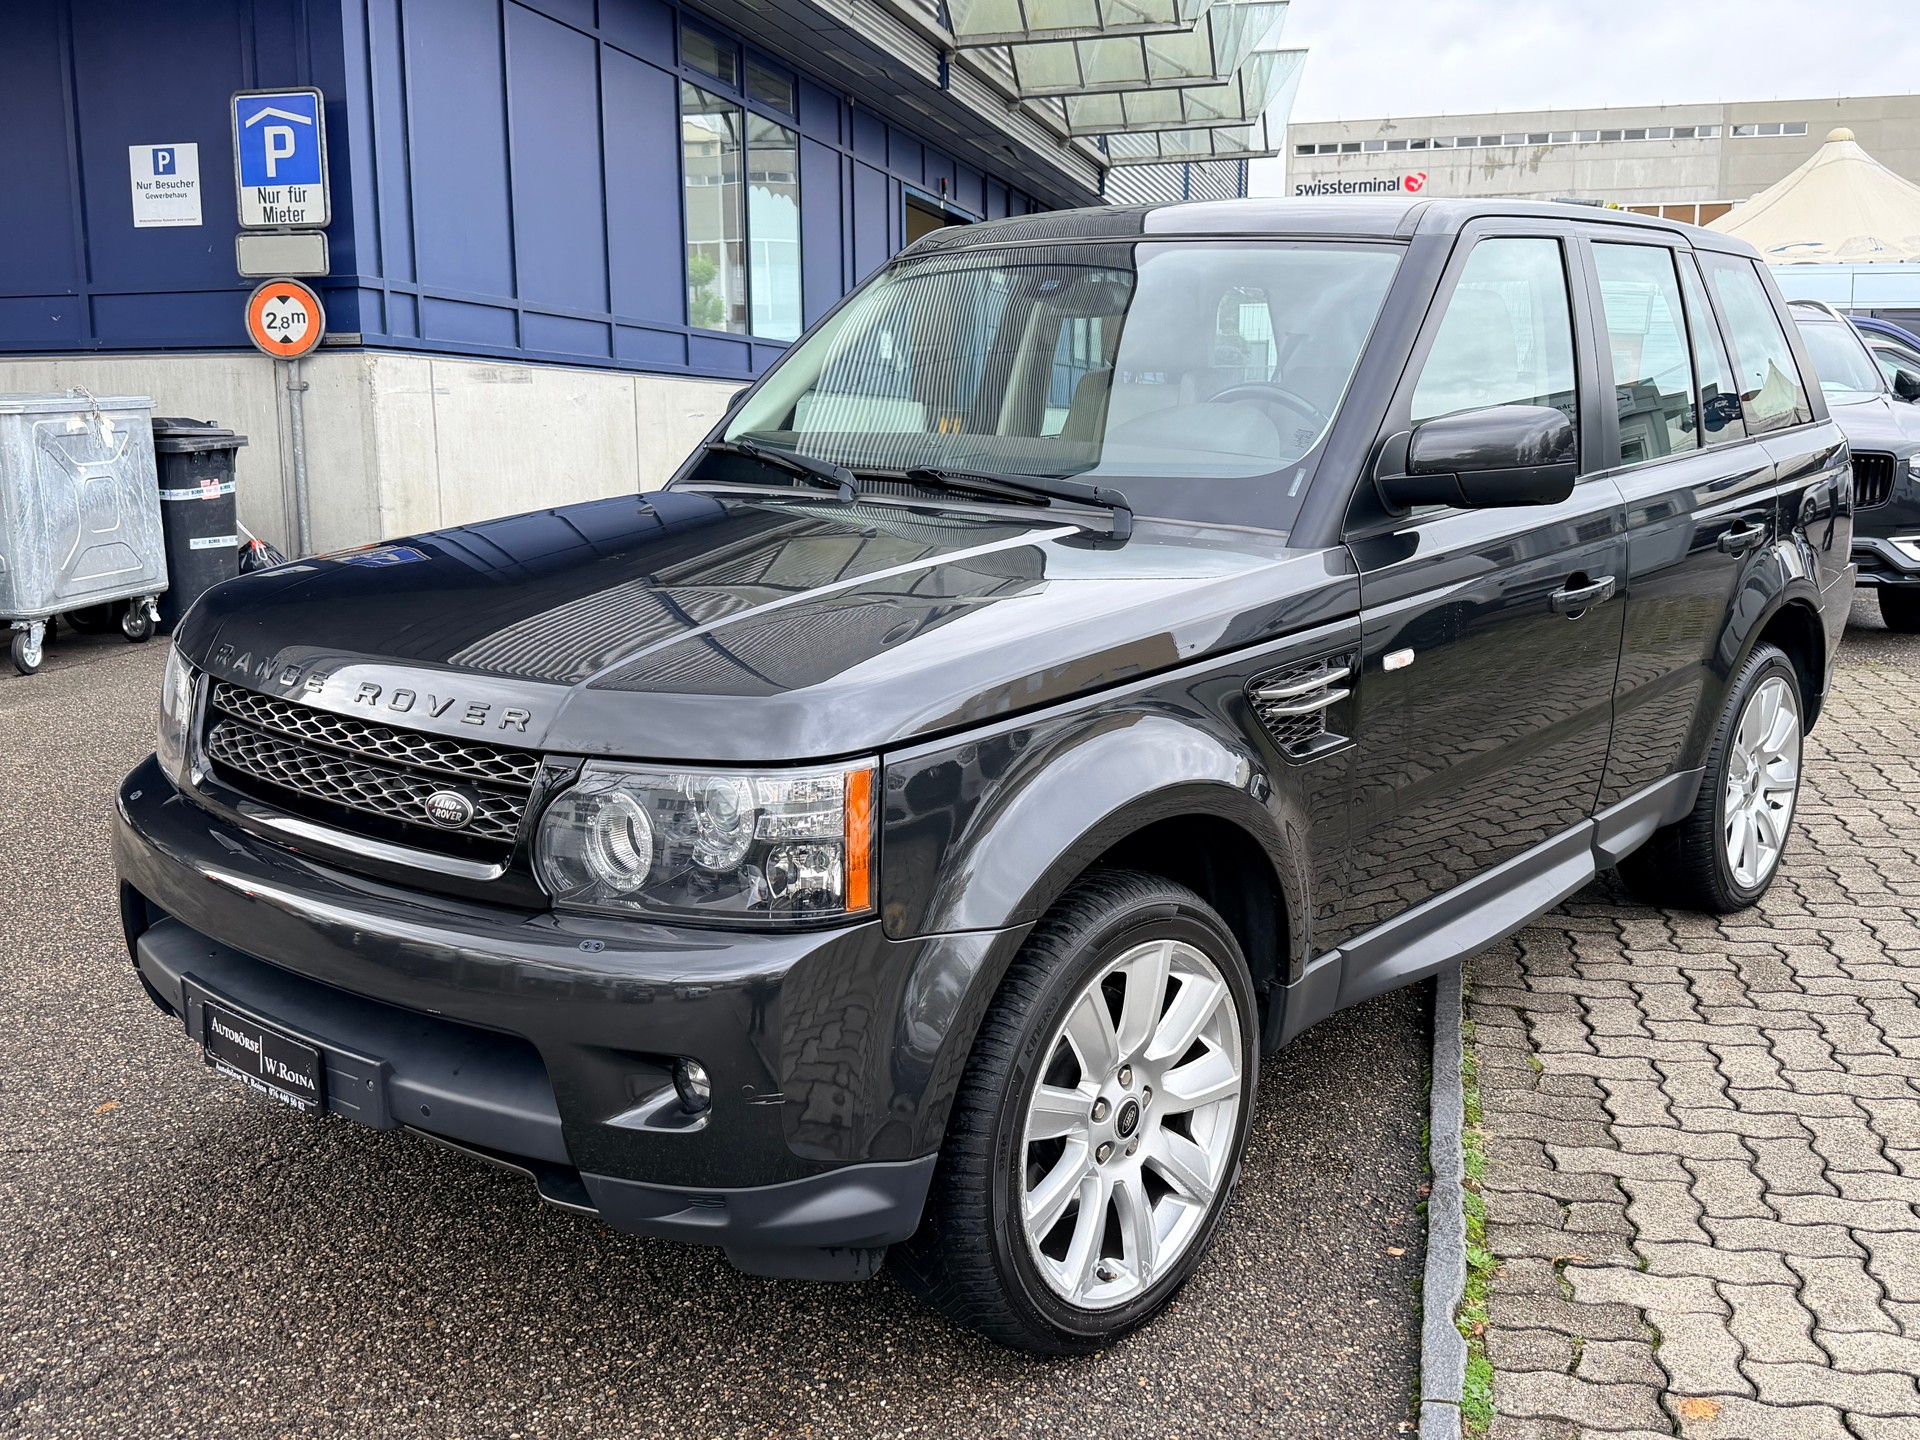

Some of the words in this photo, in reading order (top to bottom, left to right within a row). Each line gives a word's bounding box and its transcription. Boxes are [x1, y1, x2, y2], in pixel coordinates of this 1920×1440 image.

[264, 125, 296, 178] P
[157, 151, 170, 172] P
[136, 181, 152, 190] Nur
[155, 179, 195, 189] Besucher
[1295, 176, 1400, 196] swissterminal
[257, 187, 281, 204] Nur
[288, 186, 307, 203] für
[263, 206, 305, 223] Mieter
[215, 643, 330, 693] RANGE
[354, 681, 531, 732] ROVER
[434, 798, 457, 810] LAND
[435, 808, 462, 821] ROVER
[211, 1016, 260, 1053] AUTOBÖRSE
